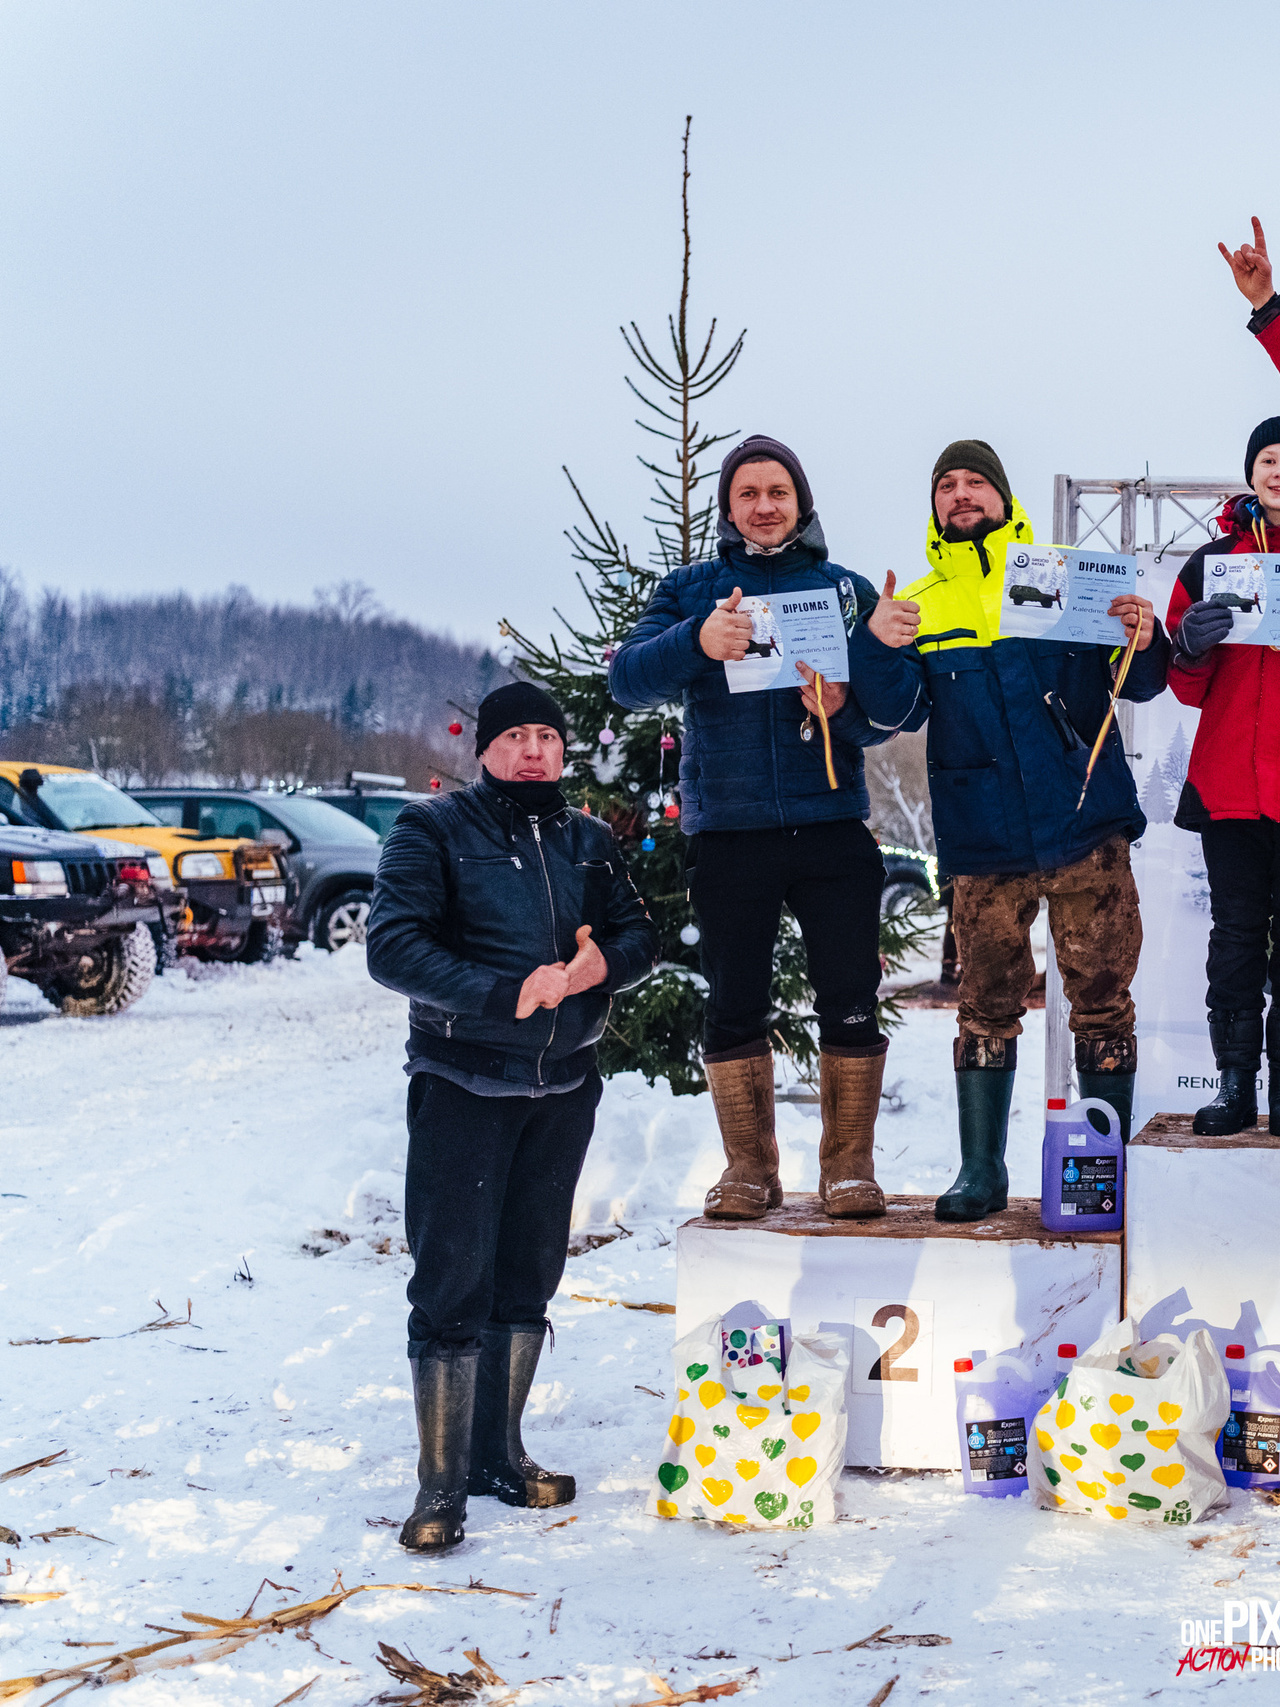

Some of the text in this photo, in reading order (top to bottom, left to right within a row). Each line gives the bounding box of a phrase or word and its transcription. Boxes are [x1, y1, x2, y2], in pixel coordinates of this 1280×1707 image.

[1079, 561, 1127, 576] DIPLOMAS
[782, 600, 830, 614] DIPLOMAS
[868, 1304, 920, 1382] 2
